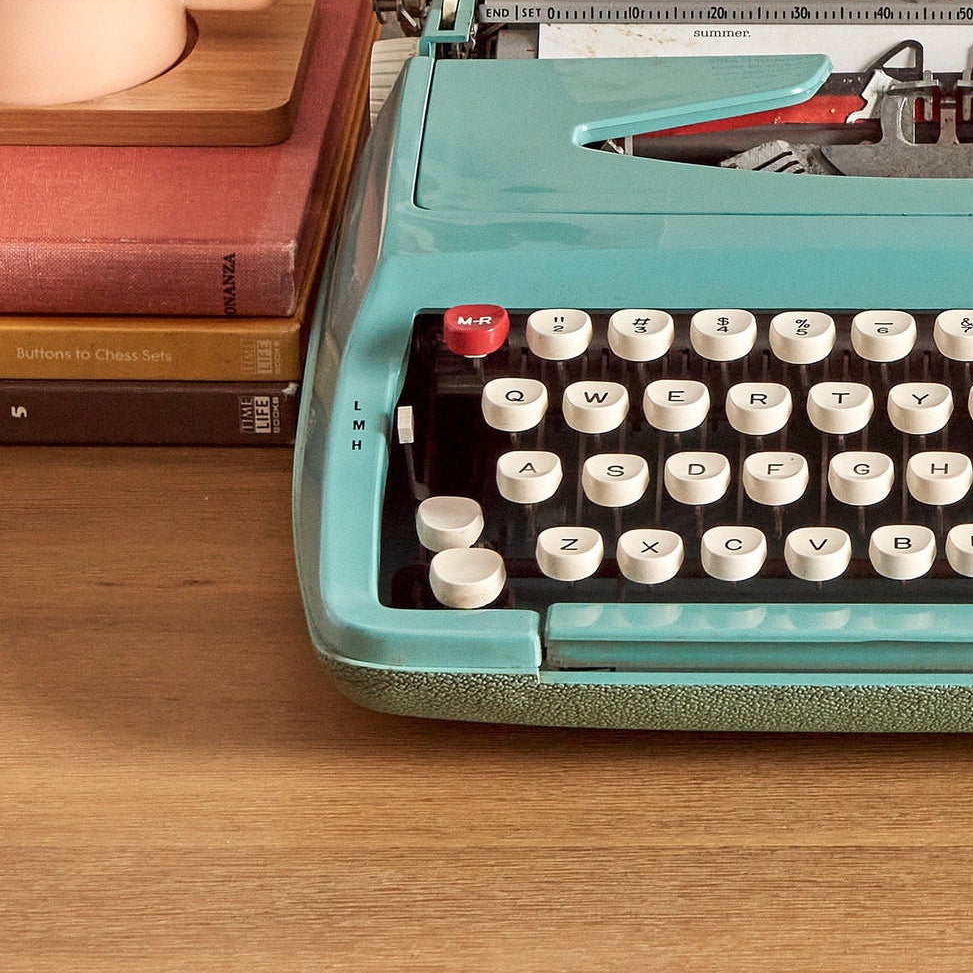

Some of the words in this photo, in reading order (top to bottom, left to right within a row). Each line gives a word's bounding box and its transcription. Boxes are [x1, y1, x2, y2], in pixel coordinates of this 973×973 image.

[486, 8, 509, 18] END
[522, 8, 541, 18] SET
[547, 7, 555, 19] 0
[629, 6, 640, 19] 10
[711, 7, 725, 20] 20
[794, 7, 808, 20] 30
[877, 7, 891, 20] 40
[960, 7, 973, 20] 50
[692, 28, 751, 38] summer.
[457, 316, 492, 326] M-R
[16, 347, 71, 360] Buttons
[75, 349, 91, 360] to
[94, 349, 138, 361] Chess
[142, 350, 172, 362] Sets
[505, 390, 525, 402] Q
[584, 391, 609, 404] W
[667, 390, 685, 402] E
[749, 393, 768, 405] R
[831, 392, 851, 404] T
[911, 393, 930, 405] Y
[11, 406, 27, 418] 5
[354, 401, 362, 411] L
[241, 397, 254, 434] TIME
[255, 398, 270, 431] LIFE
[353, 420, 365, 430] M
[352, 440, 362, 450] H
[518, 463, 537, 474] A
[606, 465, 625, 477] S
[688, 463, 706, 476] D
[767, 464, 783, 475] F
